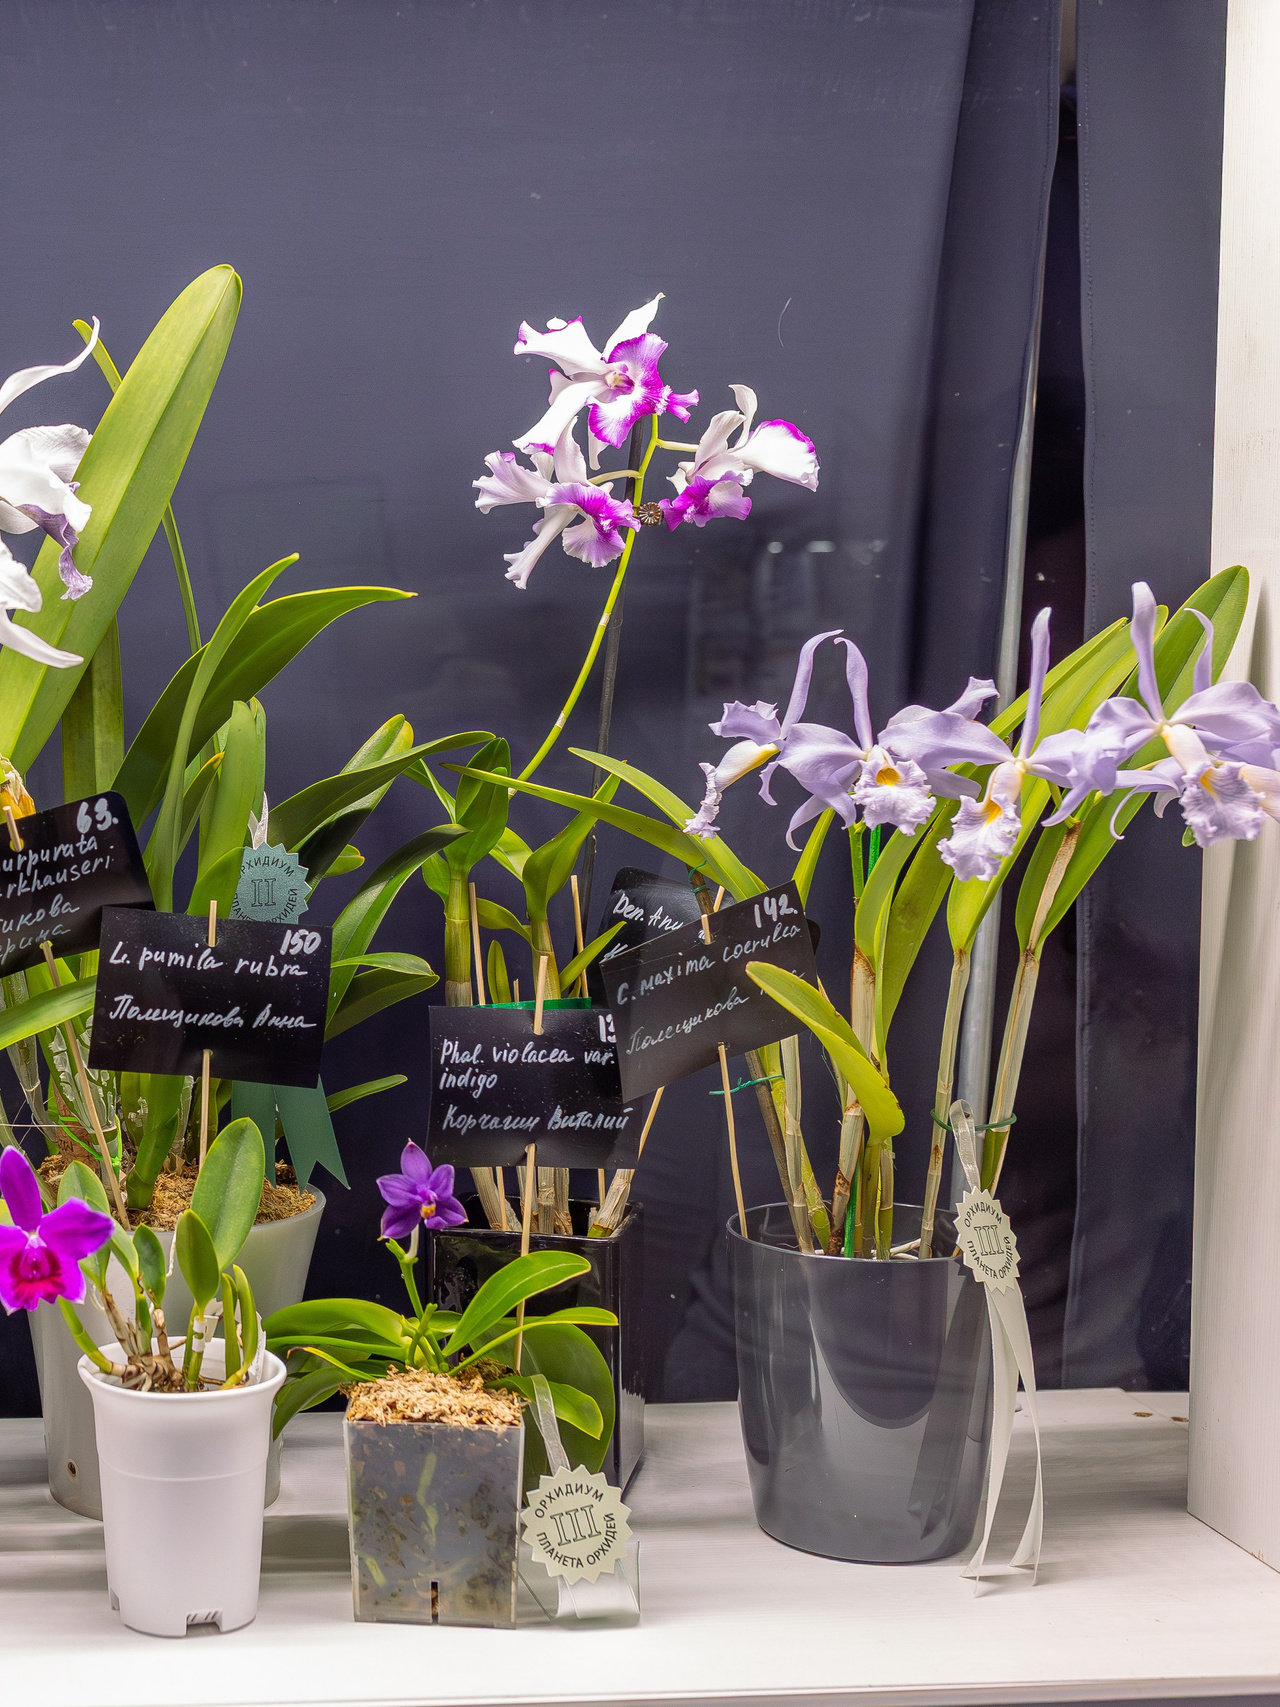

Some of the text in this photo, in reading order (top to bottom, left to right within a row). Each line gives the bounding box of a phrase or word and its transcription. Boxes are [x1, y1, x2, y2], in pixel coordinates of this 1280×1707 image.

[240, 855, 295, 878] РХИДИУМ
[251, 878, 276, 908] II
[266, 888, 298, 924] РХИДЕЙ
[279, 928, 321, 956] 150
[235, 955, 309, 977] rubra
[252, 1003, 317, 1029] Анна
[492, 1041, 575, 1064] violacea
[439, 1067, 498, 1099] indigo
[442, 1103, 634, 1136] Корчагин Виталий
[964, 1201, 1002, 1228] ОРХИДИУМ
[973, 1224, 1005, 1256] III
[967, 1236, 1014, 1279] ПЛАНЕТА ОРХИДЕЙ
[534, 1483, 604, 1518] ОРХИДИУМ
[536, 1513, 617, 1568] ПЛАНЕТА ОРХИДЕЙ
[550, 1504, 602, 1546] III
